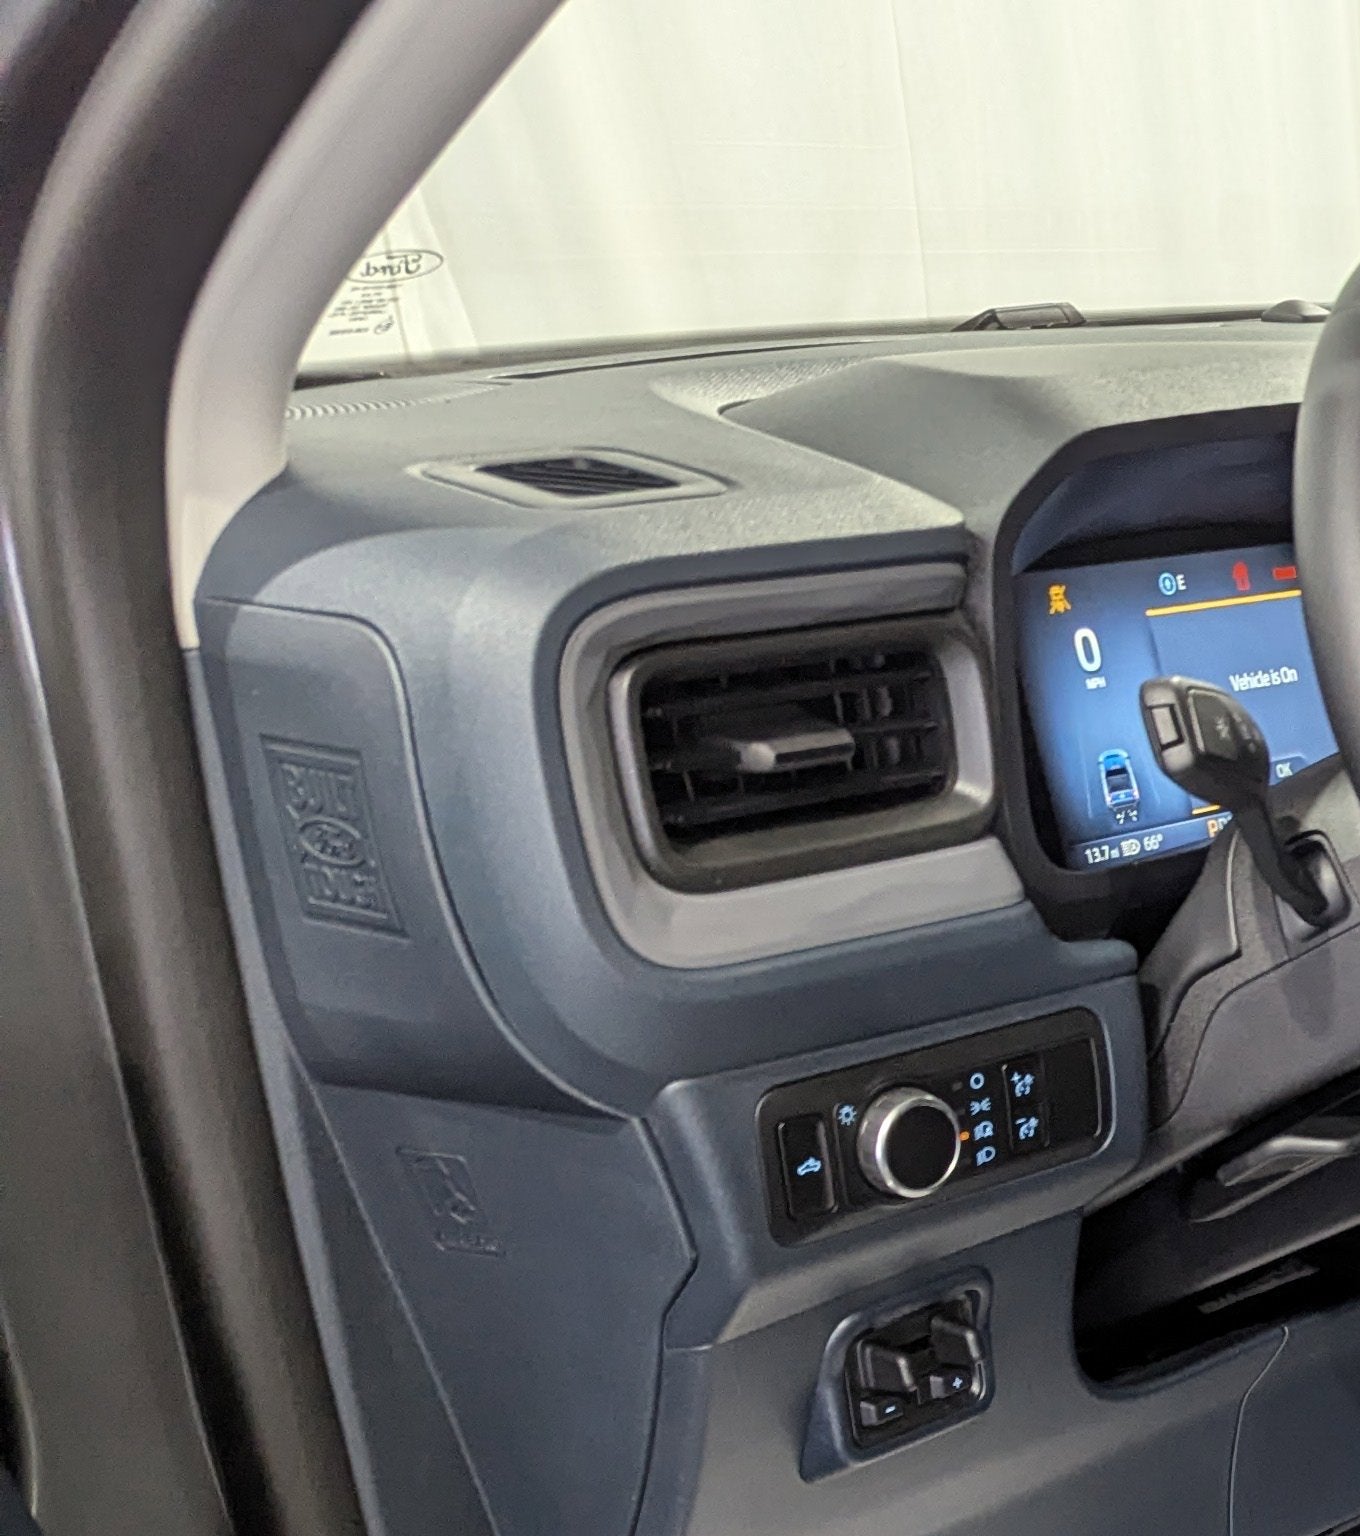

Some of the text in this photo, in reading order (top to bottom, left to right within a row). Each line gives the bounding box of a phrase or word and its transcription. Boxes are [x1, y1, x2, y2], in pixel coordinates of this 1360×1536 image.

[1074, 627, 1102, 672] 0
[1085, 675, 1107, 690] MPH
[1229, 666, 1298, 692] Vehicle is On
[1275, 762, 1293, 779] OK
[1084, 845, 1111, 865] 13.7
